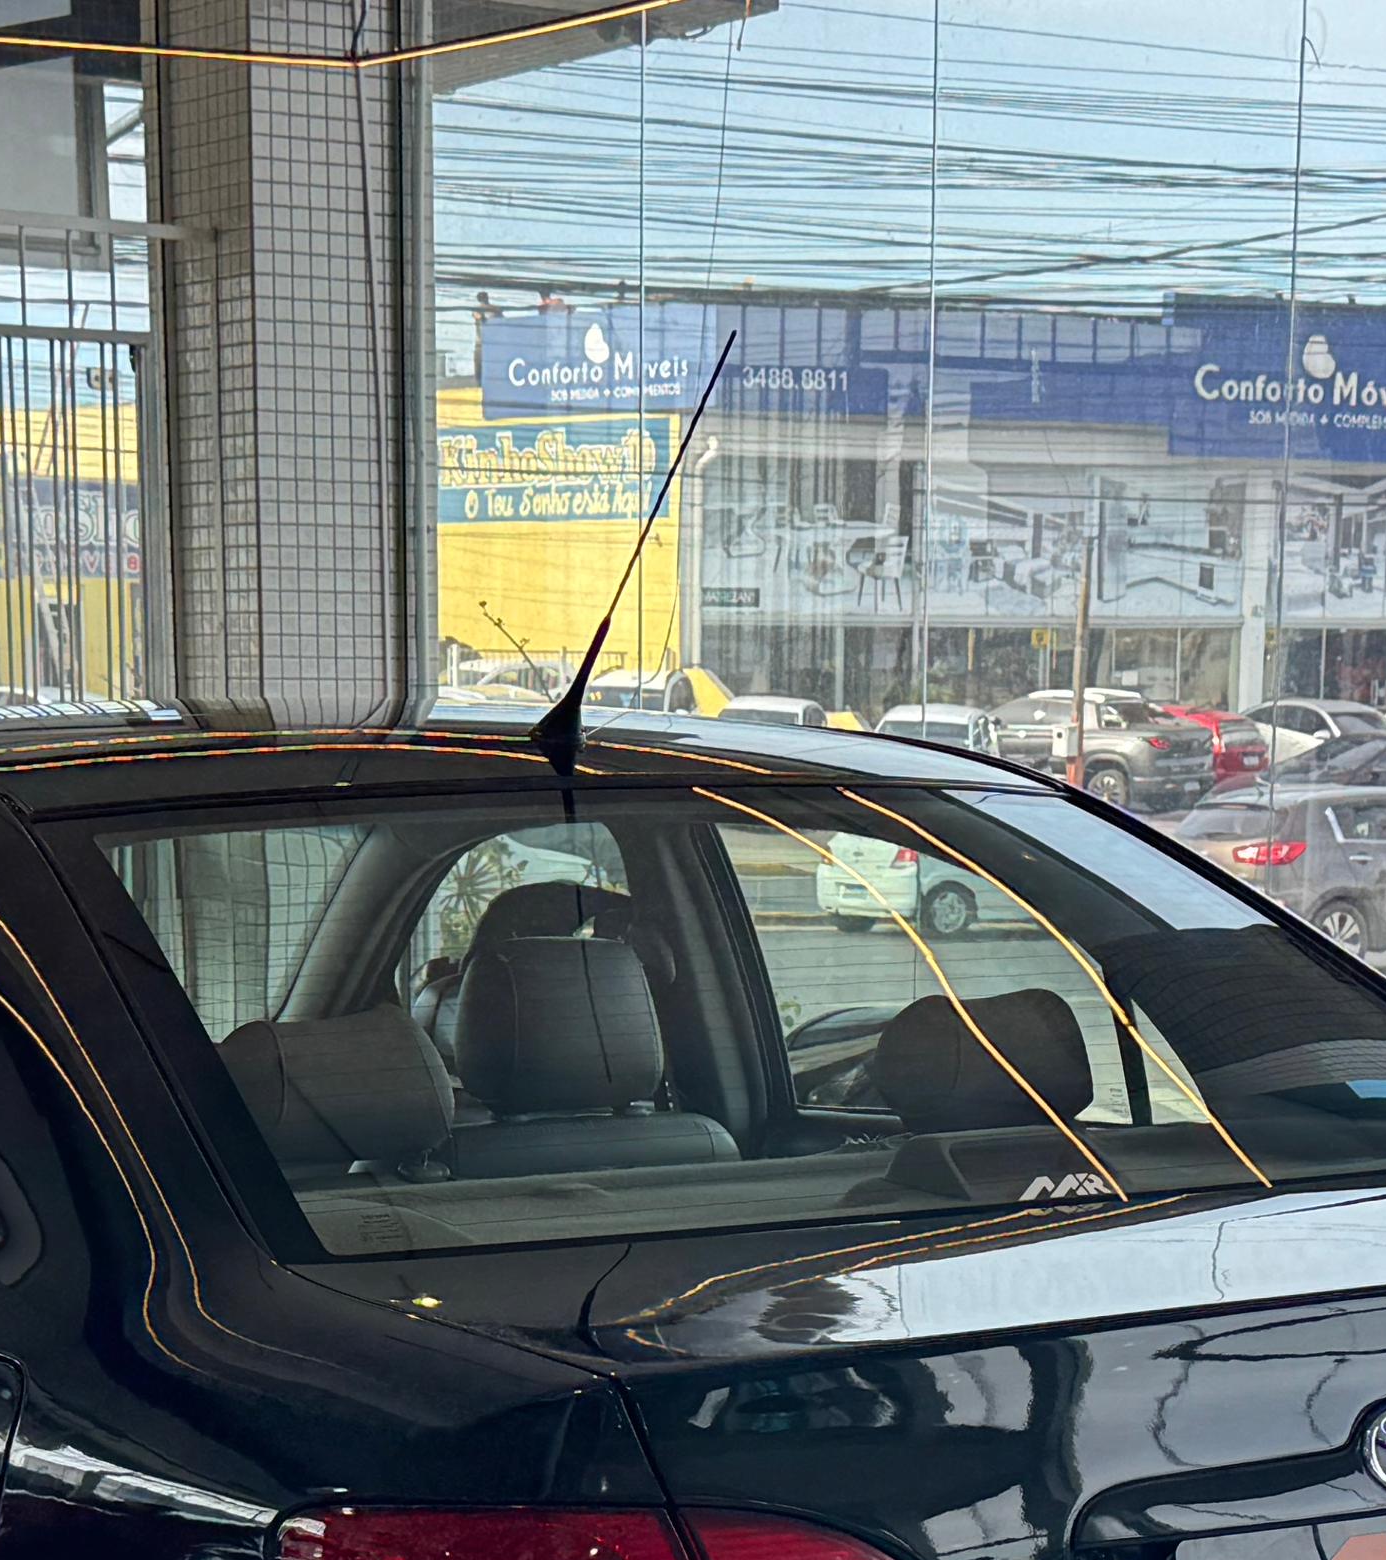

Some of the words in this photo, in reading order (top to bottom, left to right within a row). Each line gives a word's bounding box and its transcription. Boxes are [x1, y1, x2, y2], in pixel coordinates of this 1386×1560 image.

[508, 357, 604, 387] Conforto
[614, 351, 689, 381] Mveis
[742, 366, 849, 392] 3488.8811
[1249, 410, 1272, 425] SOB
[464, 489, 479, 519] O
[519, 486, 570, 517] Sonho
